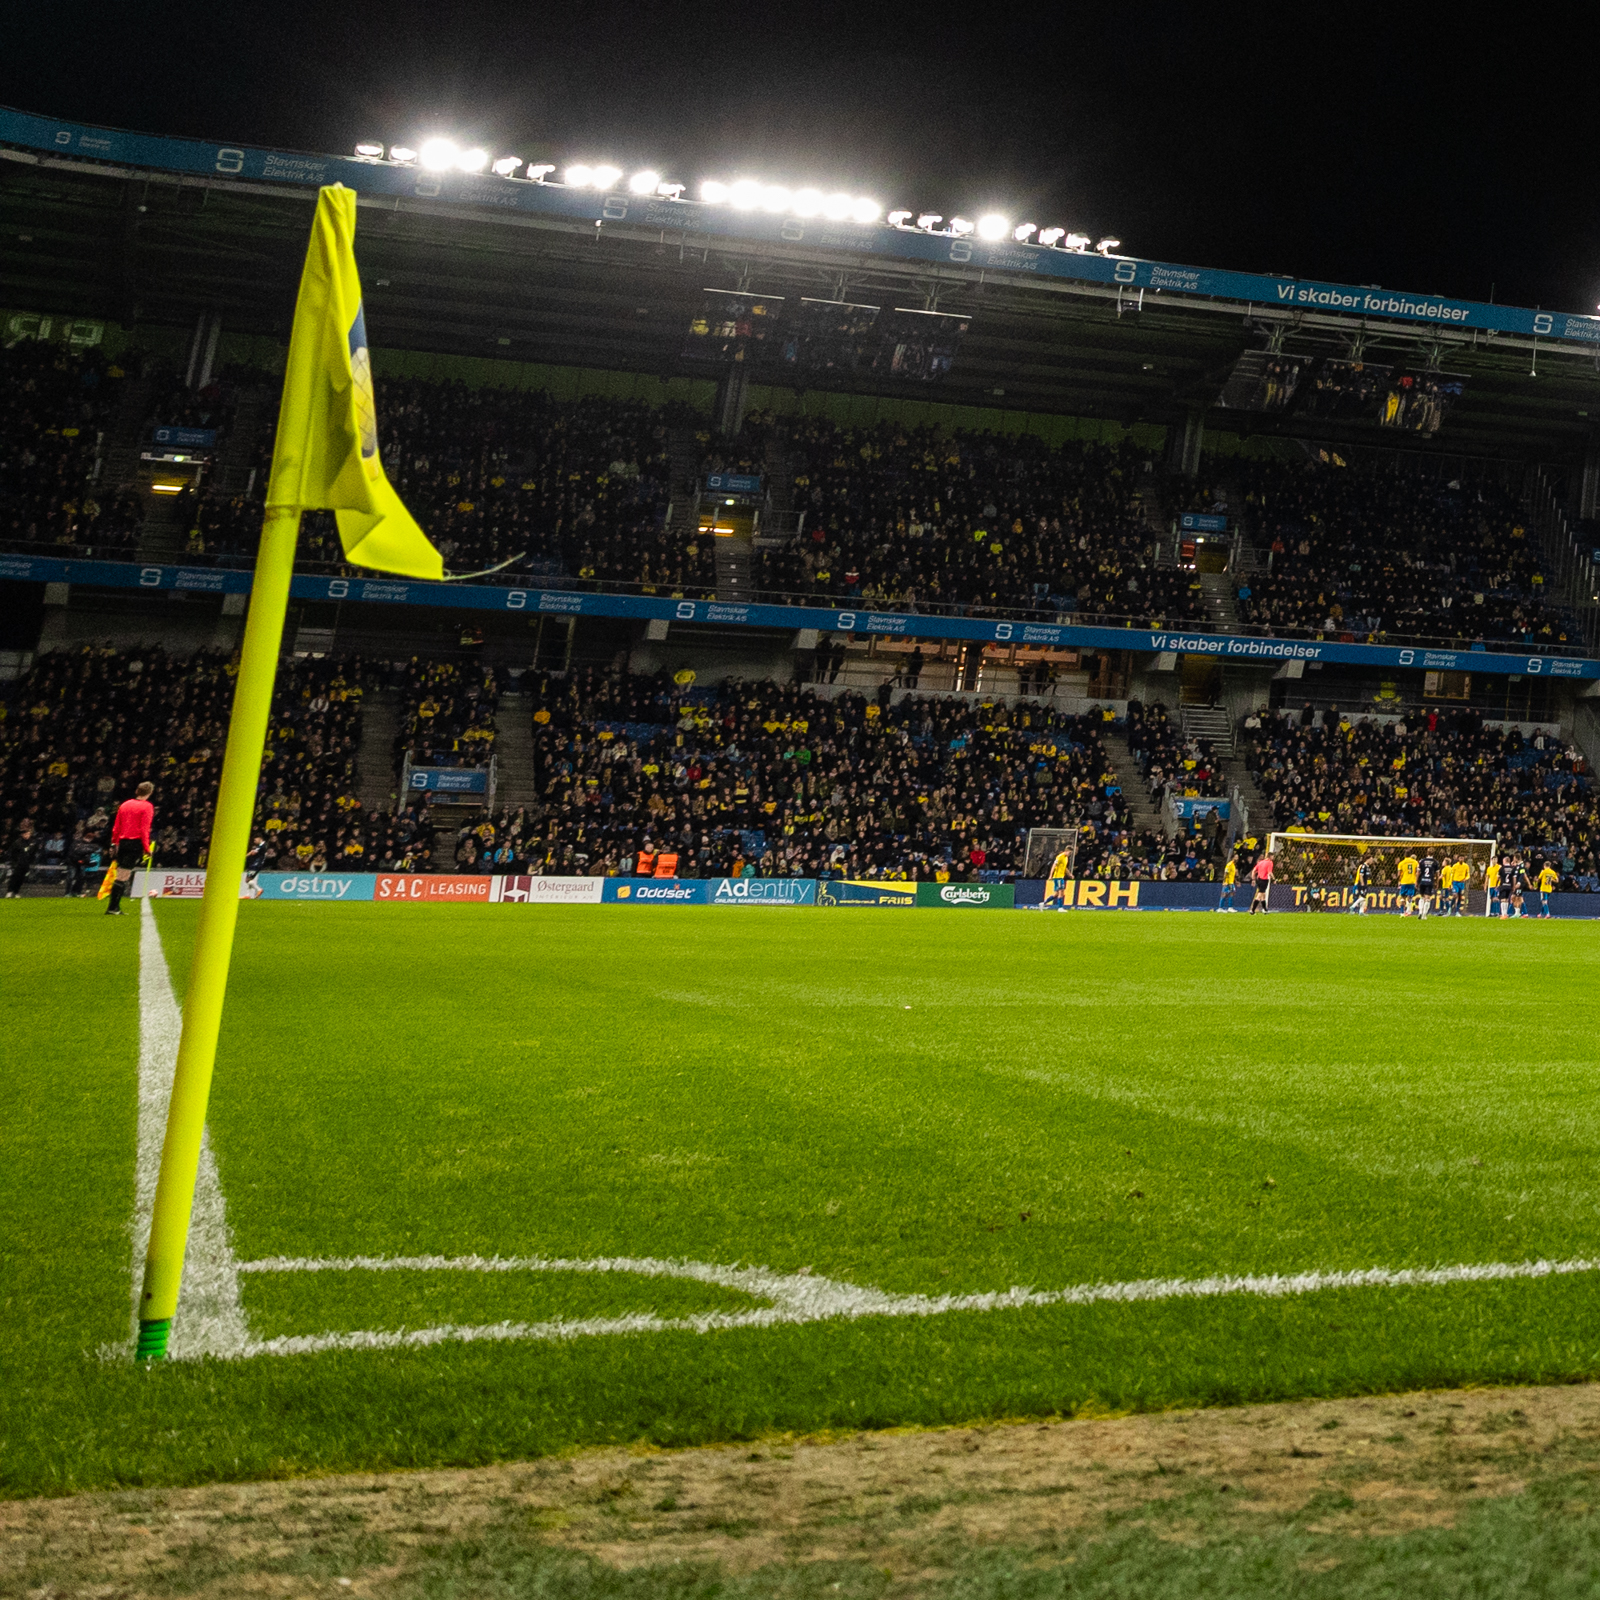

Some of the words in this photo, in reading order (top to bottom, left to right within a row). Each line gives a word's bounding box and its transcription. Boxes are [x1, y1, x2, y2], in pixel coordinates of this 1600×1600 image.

[264, 154, 327, 172] Stavnskær
[262, 166, 304, 181] Elektrik
[1151, 266, 1200, 280] Stavnskær
[1149, 276, 1182, 288] Elektrik
[1276, 284, 1295, 300] Vi
[1298, 286, 1361, 308] skaber
[1364, 293, 1470, 322] forbindelser
[1150, 635, 1166, 650] Vi
[1169, 636, 1225, 653] skaber
[1227, 640, 1322, 659] forbindelser
[164, 875, 206, 887] Bakk
[280, 877, 352, 898] dstny
[430, 883, 487, 895] LEASING
[537, 879, 595, 895] Østergaard
[636, 886, 692, 898] Oddset
[715, 878, 811, 902] Adentify
[940, 885, 991, 903] Carlsberg
[1044, 880, 1140, 907] HRH
[878, 896, 914, 905] FRIIS
